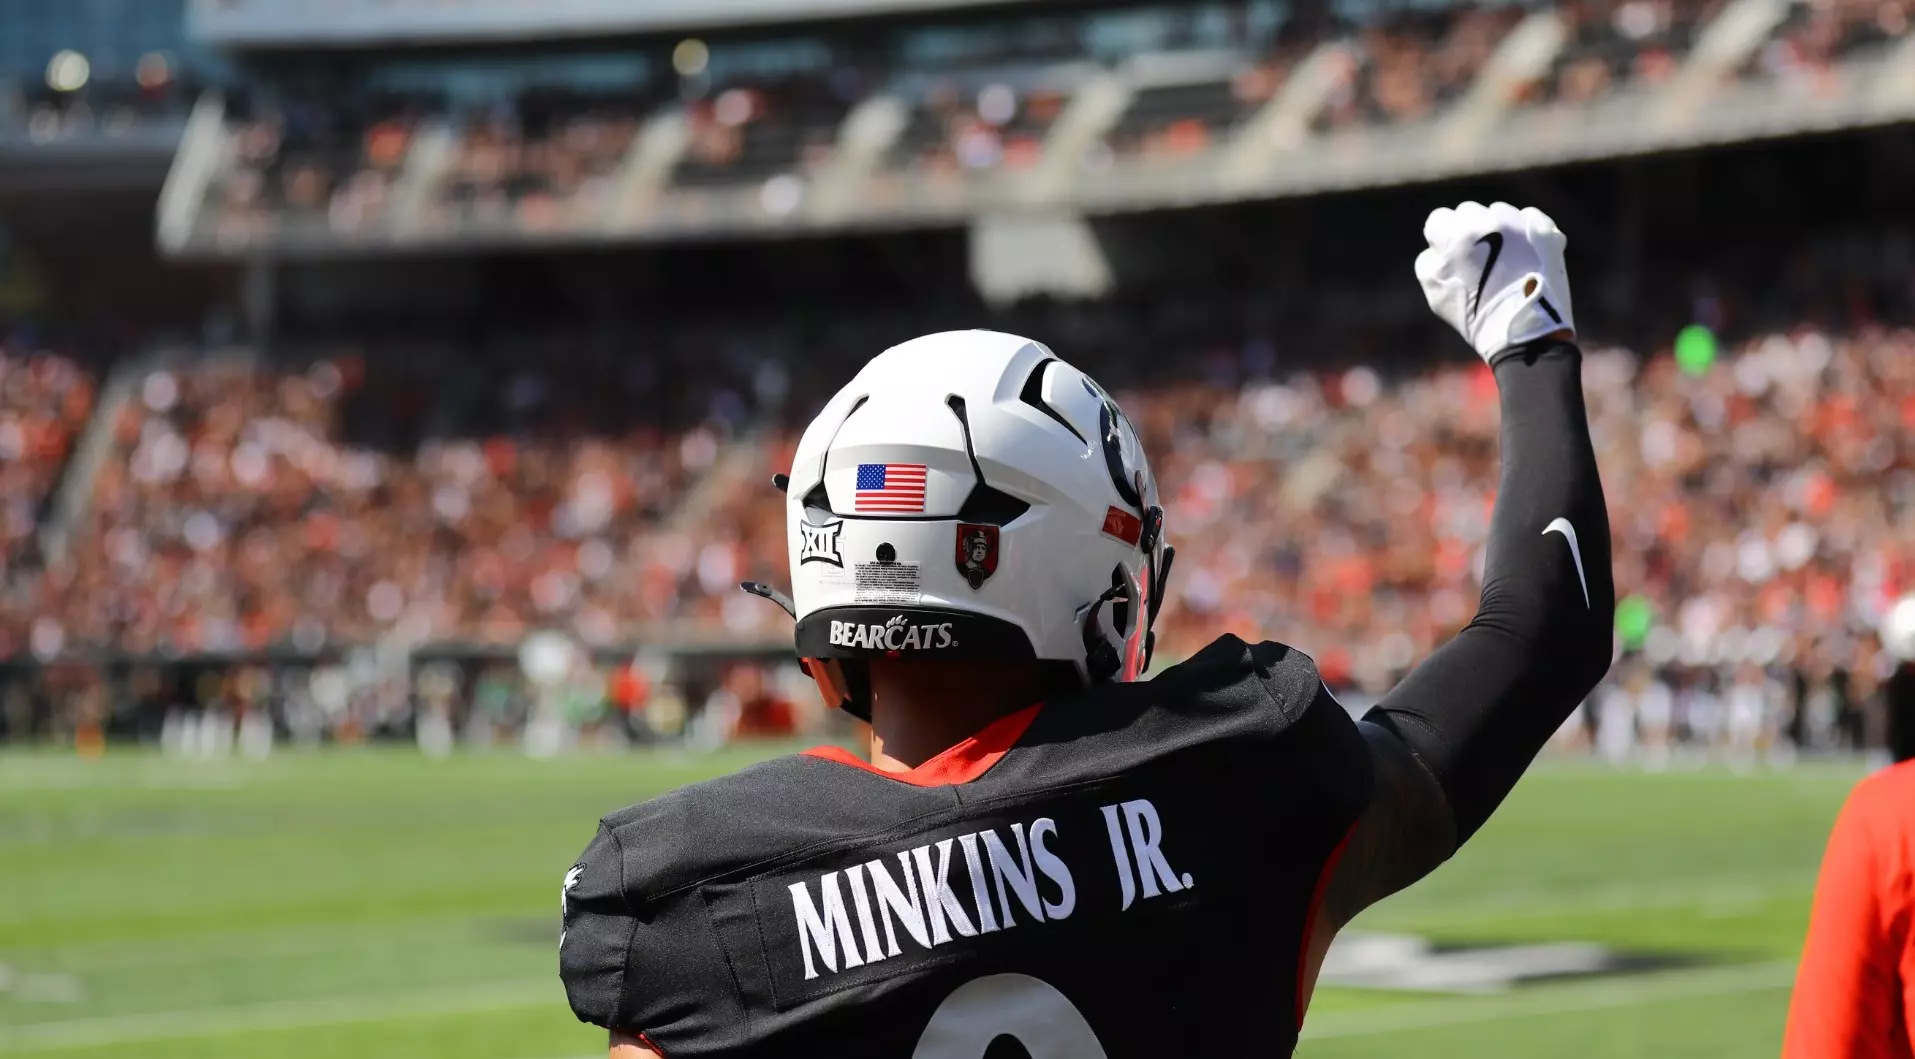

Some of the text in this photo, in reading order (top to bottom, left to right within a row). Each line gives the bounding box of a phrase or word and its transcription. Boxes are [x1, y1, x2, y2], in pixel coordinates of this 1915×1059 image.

[801, 519, 844, 568] XII
[829, 617, 953, 651] BEARCATS
[787, 799, 1195, 981] MINKINS JR.
